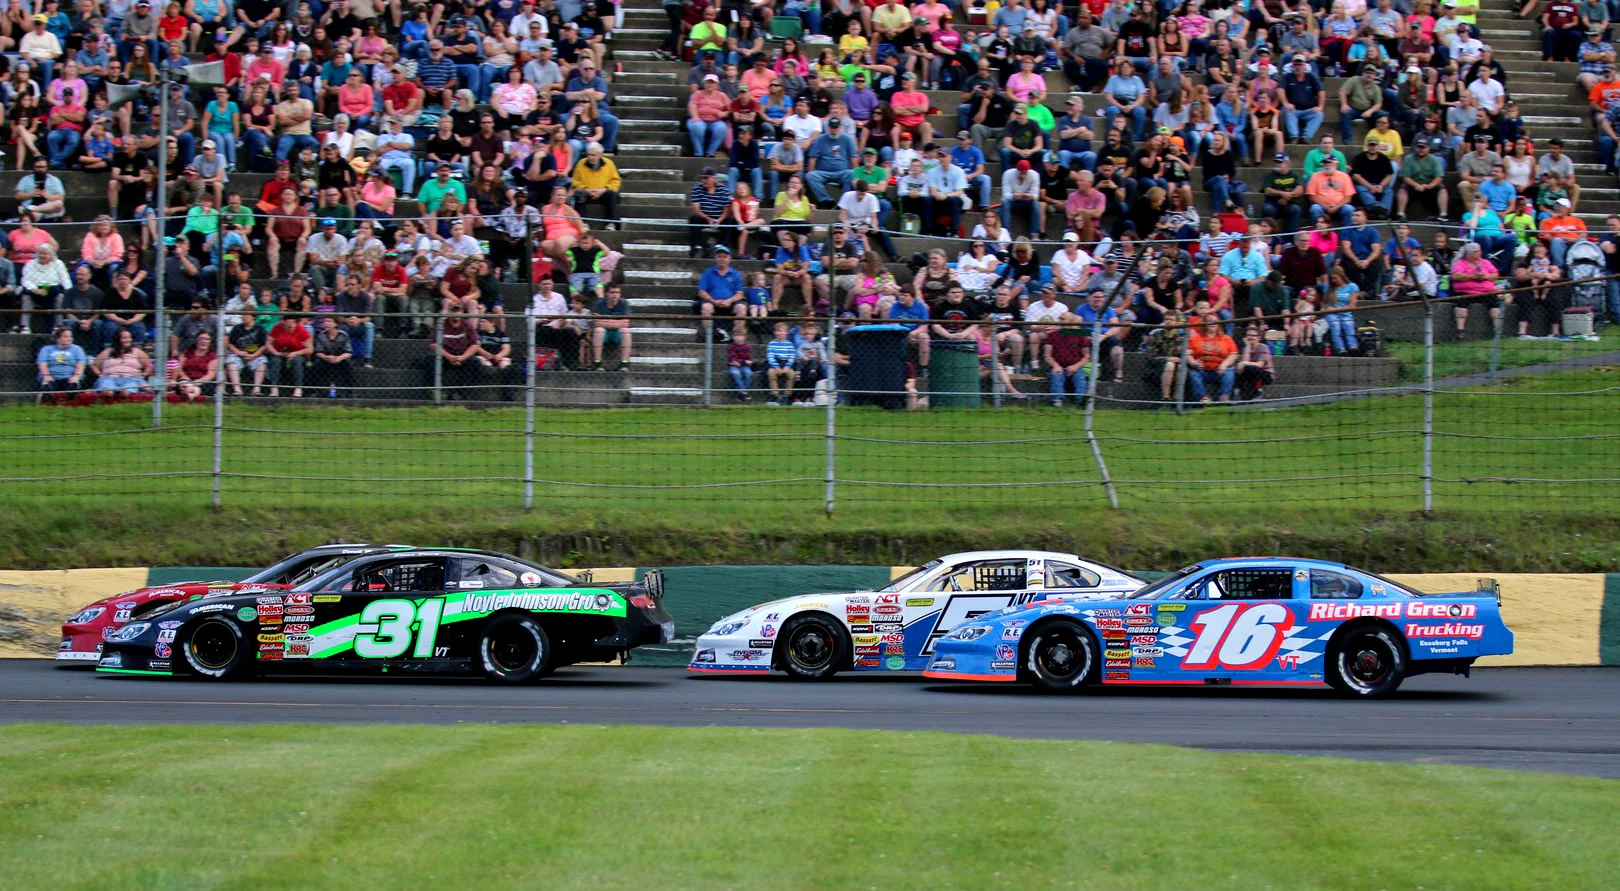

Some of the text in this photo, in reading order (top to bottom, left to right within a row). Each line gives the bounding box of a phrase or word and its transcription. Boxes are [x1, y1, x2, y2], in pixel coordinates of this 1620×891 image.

[148, 589, 186, 598] AMERICAN
[285, 594, 312, 604] ACT
[568, 592, 613, 612] Gro
[875, 595, 900, 604] ACT
[1017, 593, 1036, 605] VT
[190, 605, 235, 614] AMERICAN
[258, 605, 282, 614] Holley
[847, 605, 869, 613] Holley
[1124, 604, 1152, 615] ACT
[1310, 602, 1402, 619] Richard
[285, 624, 309, 632] MSD
[354, 597, 444, 657] 31
[1097, 618, 1121, 629] Holley
[1180, 602, 1296, 669] 16
[1407, 624, 1484, 641] Trucking
[1131, 636, 1155, 644] MSD
[1420, 640, 1468, 650] Enosburg Falls
[435, 648, 449, 657] VT
[1430, 648, 1458, 657] Vermont
[1279, 656, 1300, 669] VT
